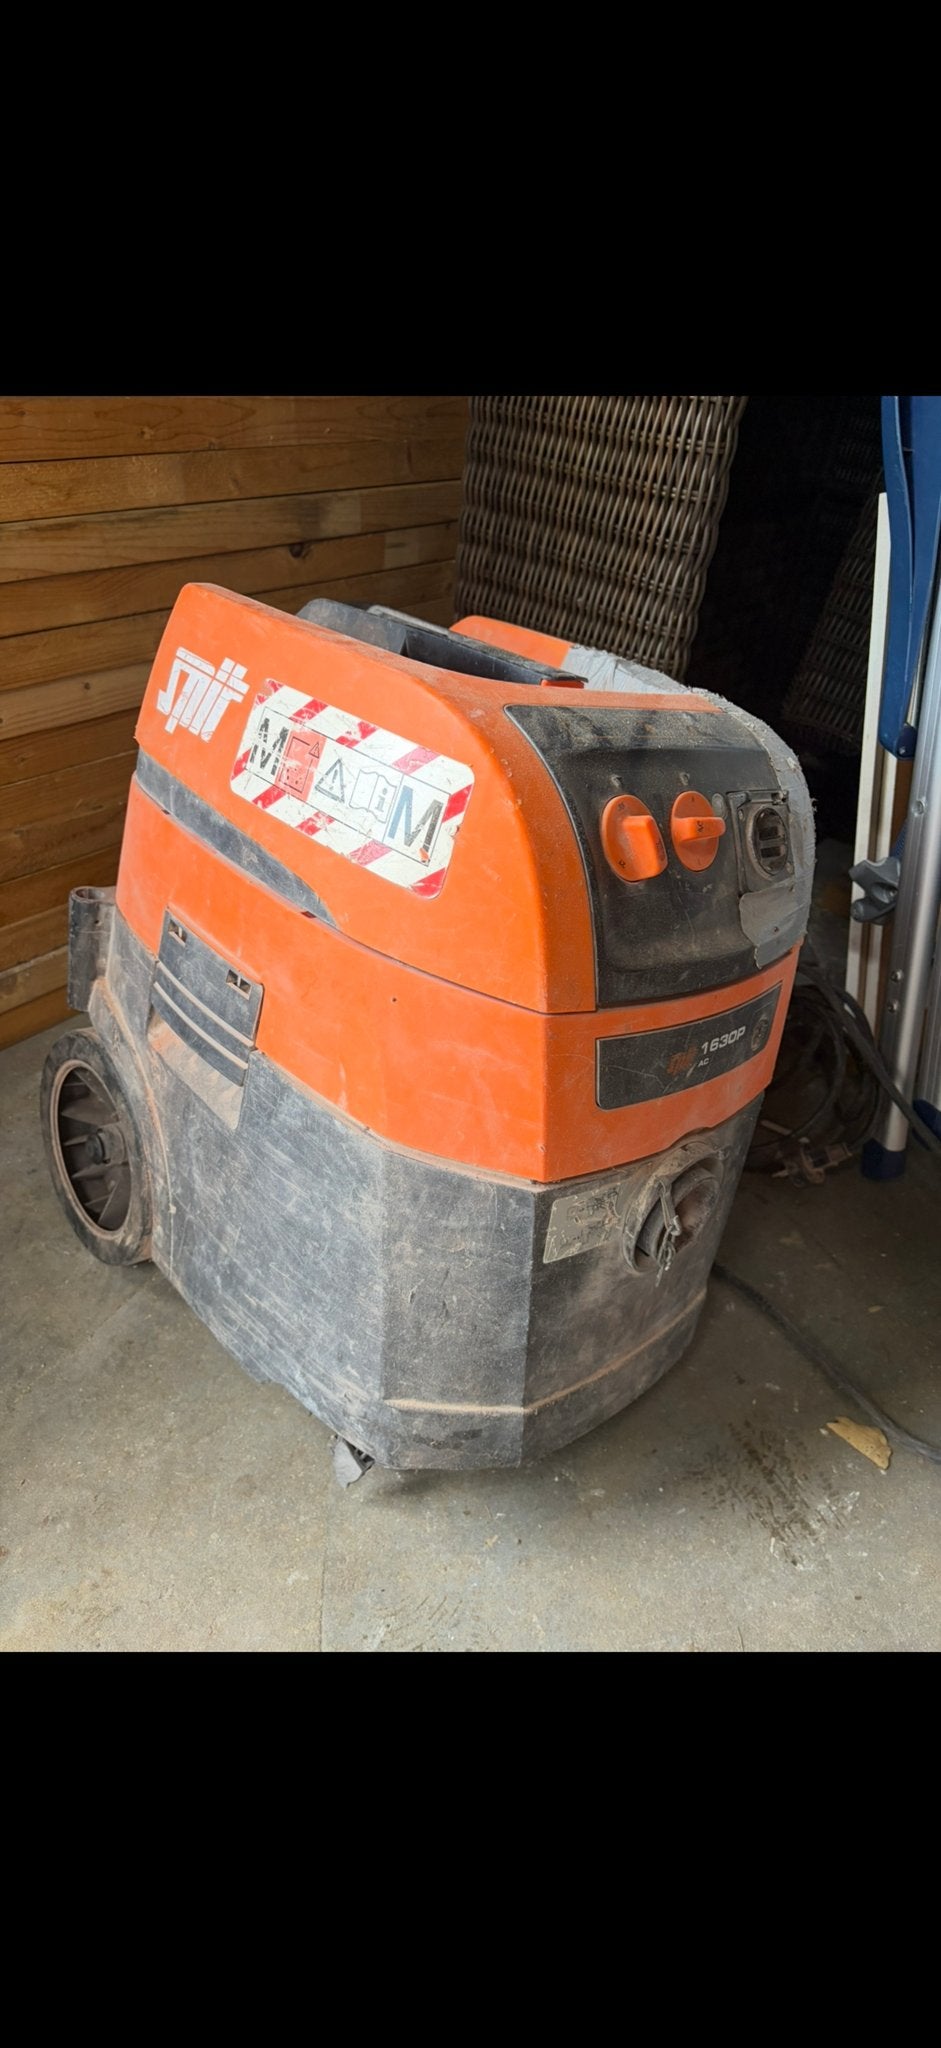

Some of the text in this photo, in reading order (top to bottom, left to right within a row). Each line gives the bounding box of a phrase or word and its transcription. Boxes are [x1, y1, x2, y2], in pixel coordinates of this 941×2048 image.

[388, 784, 444, 863] M
[701, 1026, 746, 1055] 1630P
[698, 1057, 710, 1067] AC
